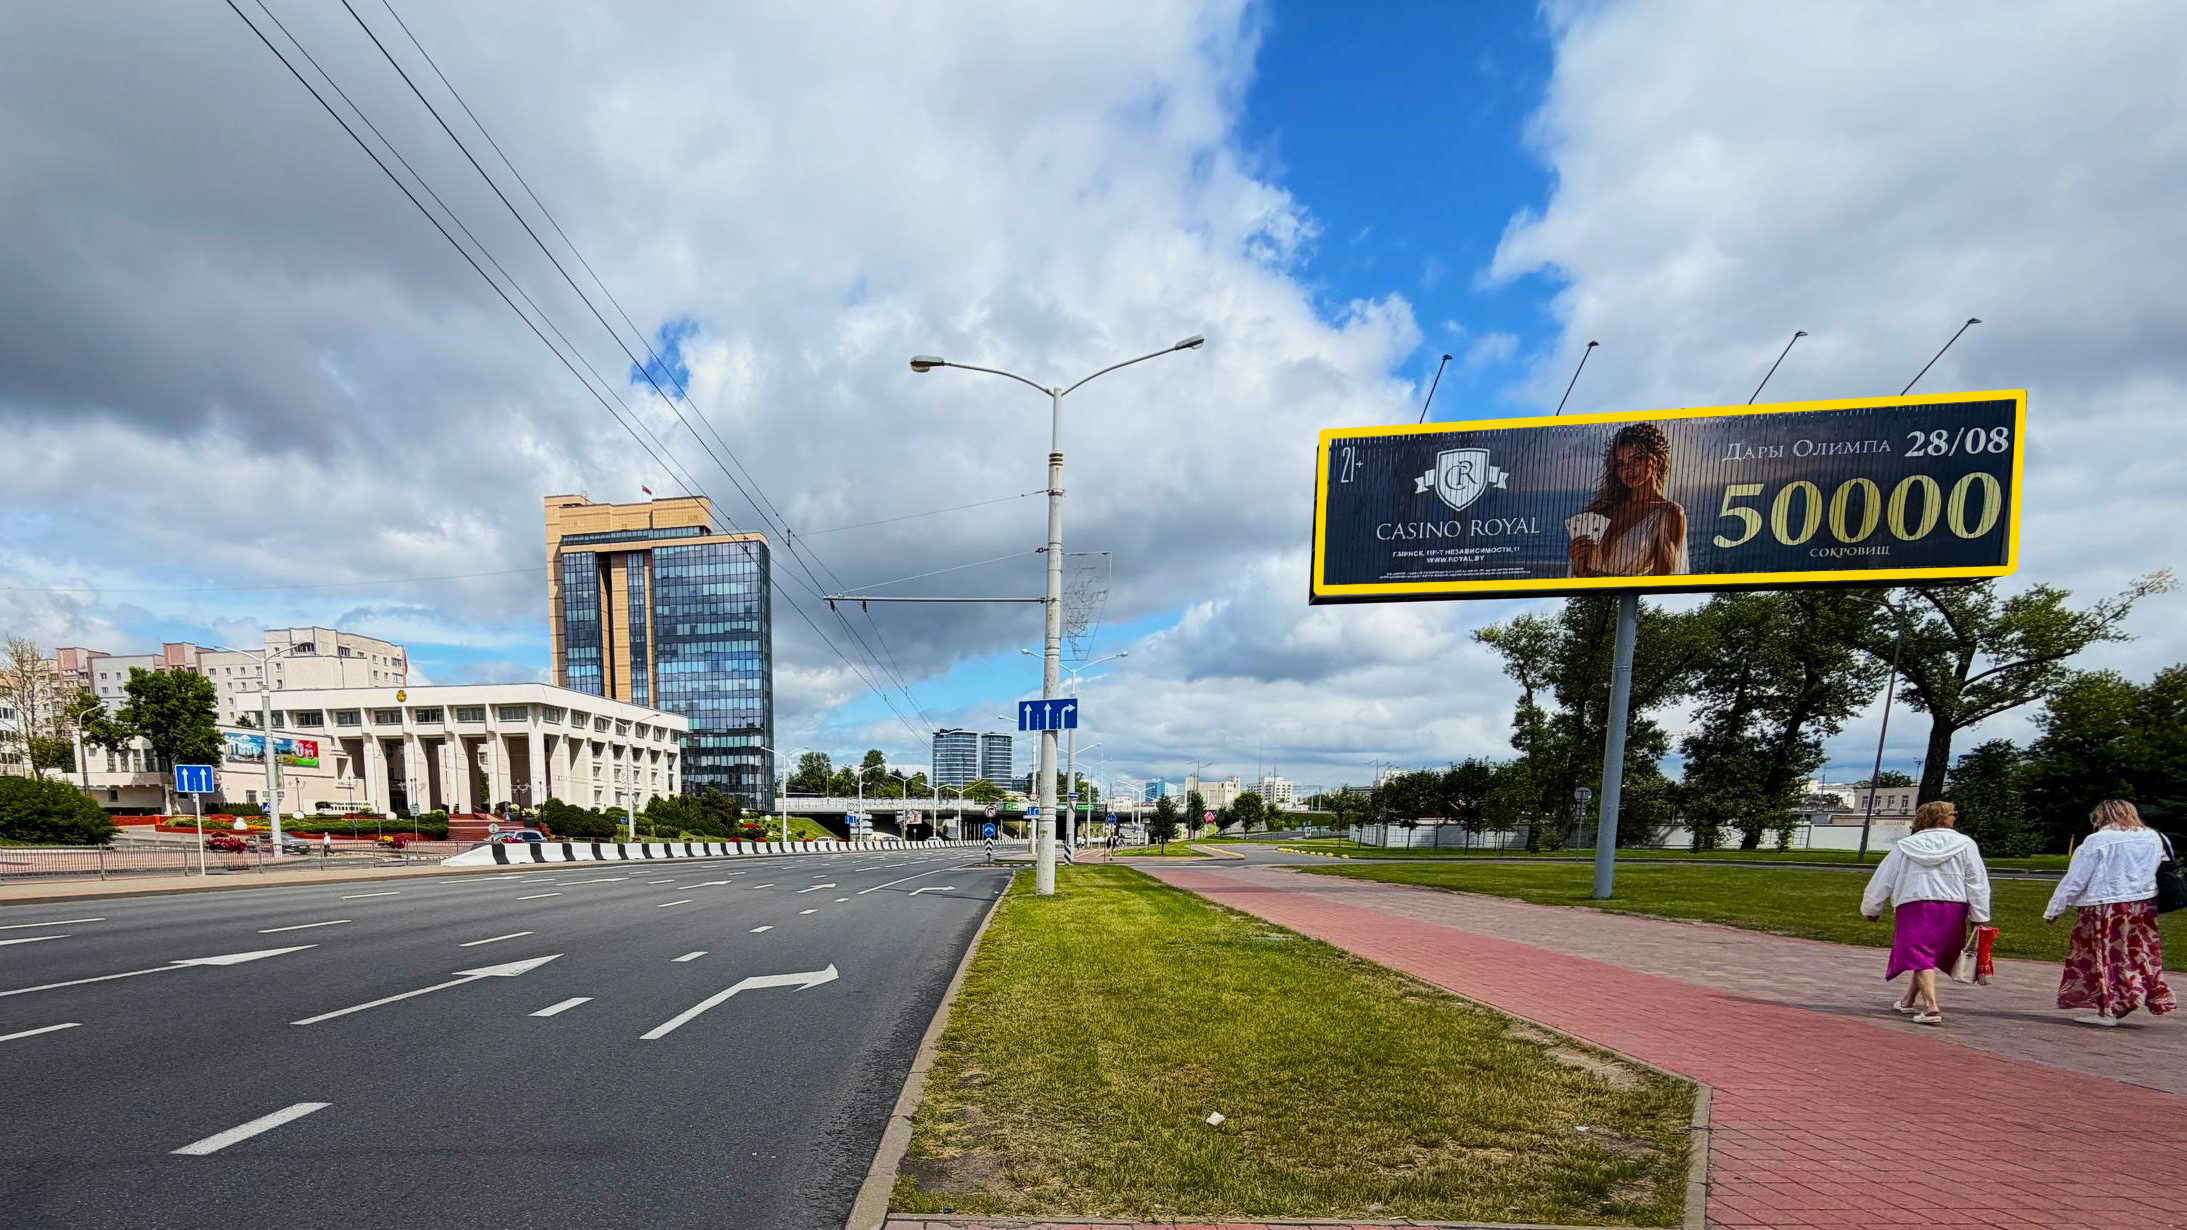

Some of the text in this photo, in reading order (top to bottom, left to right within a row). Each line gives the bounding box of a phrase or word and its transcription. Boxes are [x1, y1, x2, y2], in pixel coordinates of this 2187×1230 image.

[1904, 426, 2009, 458] 28/08
[1341, 446, 1363, 483] 21+
[1713, 471, 2002, 549] 50000
[1376, 517, 1541, 541] CASINO ROYAL
